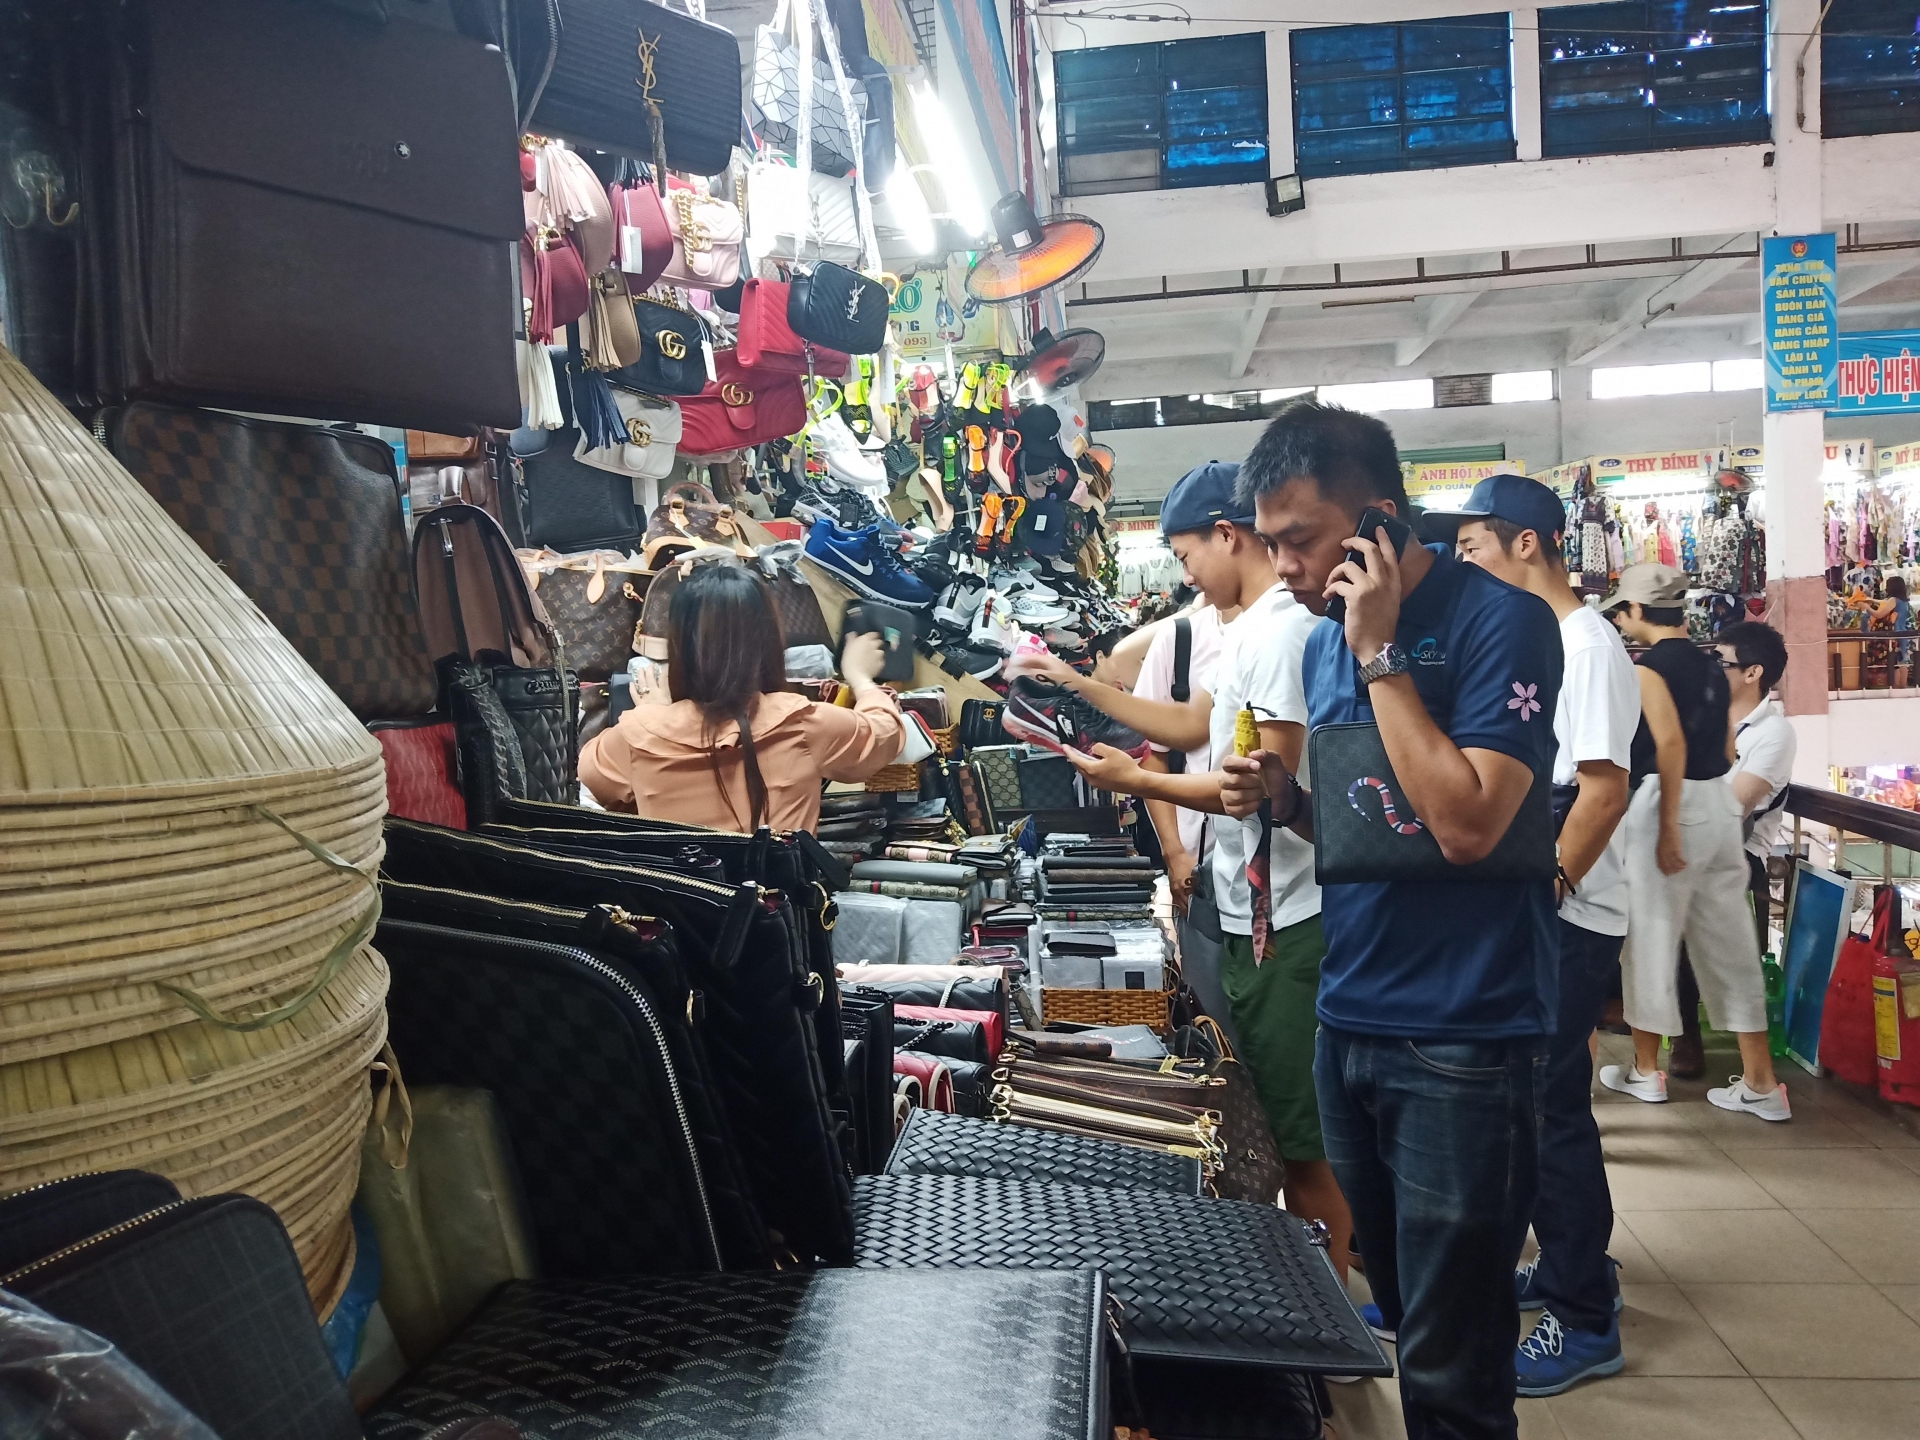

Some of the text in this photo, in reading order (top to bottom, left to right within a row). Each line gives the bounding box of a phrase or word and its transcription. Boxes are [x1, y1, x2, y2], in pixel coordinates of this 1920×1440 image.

[1775, 299, 1826, 312] BUÔN BÁN
[1776, 313, 1804, 325] HÀNG
[1774, 326, 1802, 338] HÀNG
[1773, 339, 1800, 351] HÀNG
[1625, 457, 1657, 473] THY
[1450, 465, 1472, 481] HỘI
[1475, 467, 1494, 478] AN
[1127, 519, 1155, 531] MINH
